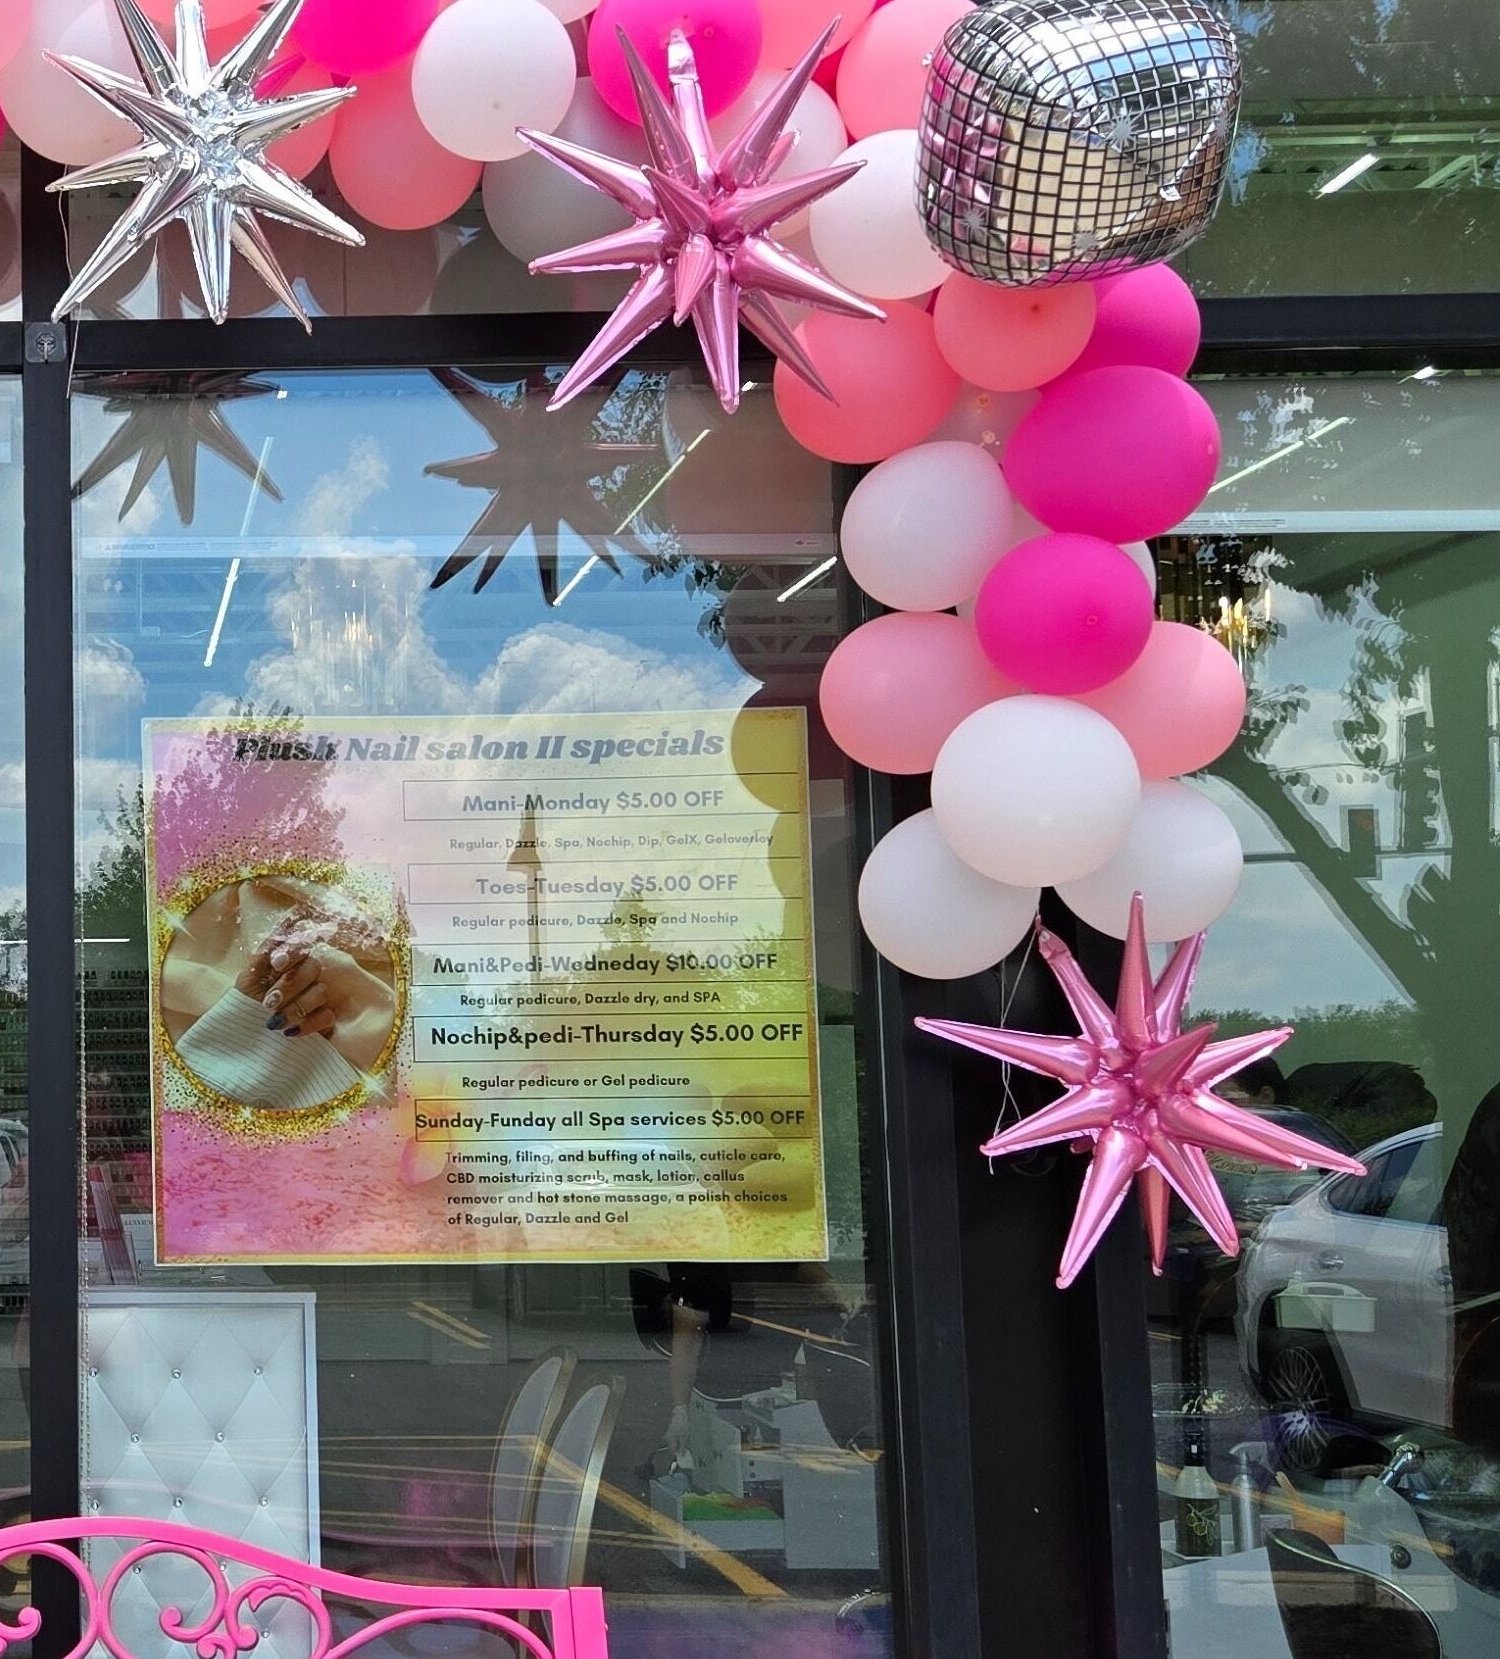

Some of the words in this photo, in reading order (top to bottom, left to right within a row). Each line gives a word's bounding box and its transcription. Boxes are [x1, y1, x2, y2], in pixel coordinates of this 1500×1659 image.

[233, 734, 339, 762] Plush
[344, 735, 421, 762] Nail
[424, 734, 529, 761] salon
[534, 735, 567, 760] II
[570, 729, 725, 765] specials
[463, 792, 611, 815] Mani-Monday
[616, 790, 677, 811] $5.00
[684, 790, 724, 807] OFF
[450, 837, 502, 851] Regular,
[506, 837, 551, 850] Dazzle,
[555, 837, 583, 850] Spa,
[586, 835, 634, 850] Nochip,
[638, 834, 663, 848] Dip,
[666, 833, 701, 846] GelX,
[476, 875, 625, 898] Toes-Tuesday
[631, 873, 691, 895] $5.00
[698, 874, 739, 891] OFF
[452, 915, 505, 931] Regular
[509, 914, 573, 930] pedicure,
[576, 913, 626, 927] Dazzle,
[629, 913, 657, 928] Spa
[660, 911, 687, 925] and
[690, 911, 739, 926] Nochip
[433, 953, 660, 976] Mani&Pedi-Wedneday
[666, 953, 732, 972] $10.00
[738, 953, 778, 970] OFF
[460, 993, 513, 1009] Regular
[517, 993, 581, 1008] pedicure,
[585, 992, 630, 1005] Dazzle
[634, 991, 660, 1007] dry,
[663, 991, 689, 1004] and
[693, 991, 721, 1004] SPA
[431, 1023, 684, 1049] Nochip&pedi-Thursday
[690, 1022, 755, 1044] $5.00
[761, 1023, 803, 1041] OFF
[462, 1075, 515, 1091] Regular
[518, 1074, 579, 1090] pedicure
[583, 1076, 598, 1087] or
[601, 1074, 625, 1087] Gel
[629, 1073, 690, 1089] pedicure
[415, 1111, 557, 1133] Sunday-Funday
[561, 1111, 583, 1127] all
[588, 1111, 625, 1131] Spa
[630, 1111, 707, 1126] services
[711, 1109, 765, 1127] $5.00
[770, 1110, 805, 1125] OFF
[445, 1152, 512, 1166] Trimming,
[515, 1150, 553, 1166] filing,
[558, 1150, 585, 1163] and
[588, 1149, 638, 1164] buffing
[641, 1149, 656, 1161] of
[659, 1149, 696, 1163] nails,
[699, 1149, 747, 1161] cuticle
[750, 1151, 786, 1162] care,
[446, 1172, 475, 1184] CBD
[478, 1172, 563, 1186] moisturizing
[566, 1170, 609, 1184] scrub,
[613, 1169, 653, 1184] mask,
[657, 1169, 700, 1182] lotion,
[703, 1169, 745, 1181] callus
[447, 1194, 503, 1205] remover
[507, 1192, 533, 1204] and
[537, 1191, 559, 1203] hot
[563, 1192, 601, 1203] stone
[605, 1192, 672, 1206] massage,
[675, 1192, 685, 1202] a
[688, 1190, 730, 1205] polish
[734, 1190, 788, 1202] choices
[448, 1212, 462, 1225] of
[465, 1212, 522, 1227] Regular,
[526, 1211, 571, 1224] Dazzle
[574, 1211, 601, 1224] and
[605, 1211, 629, 1223] Gel
